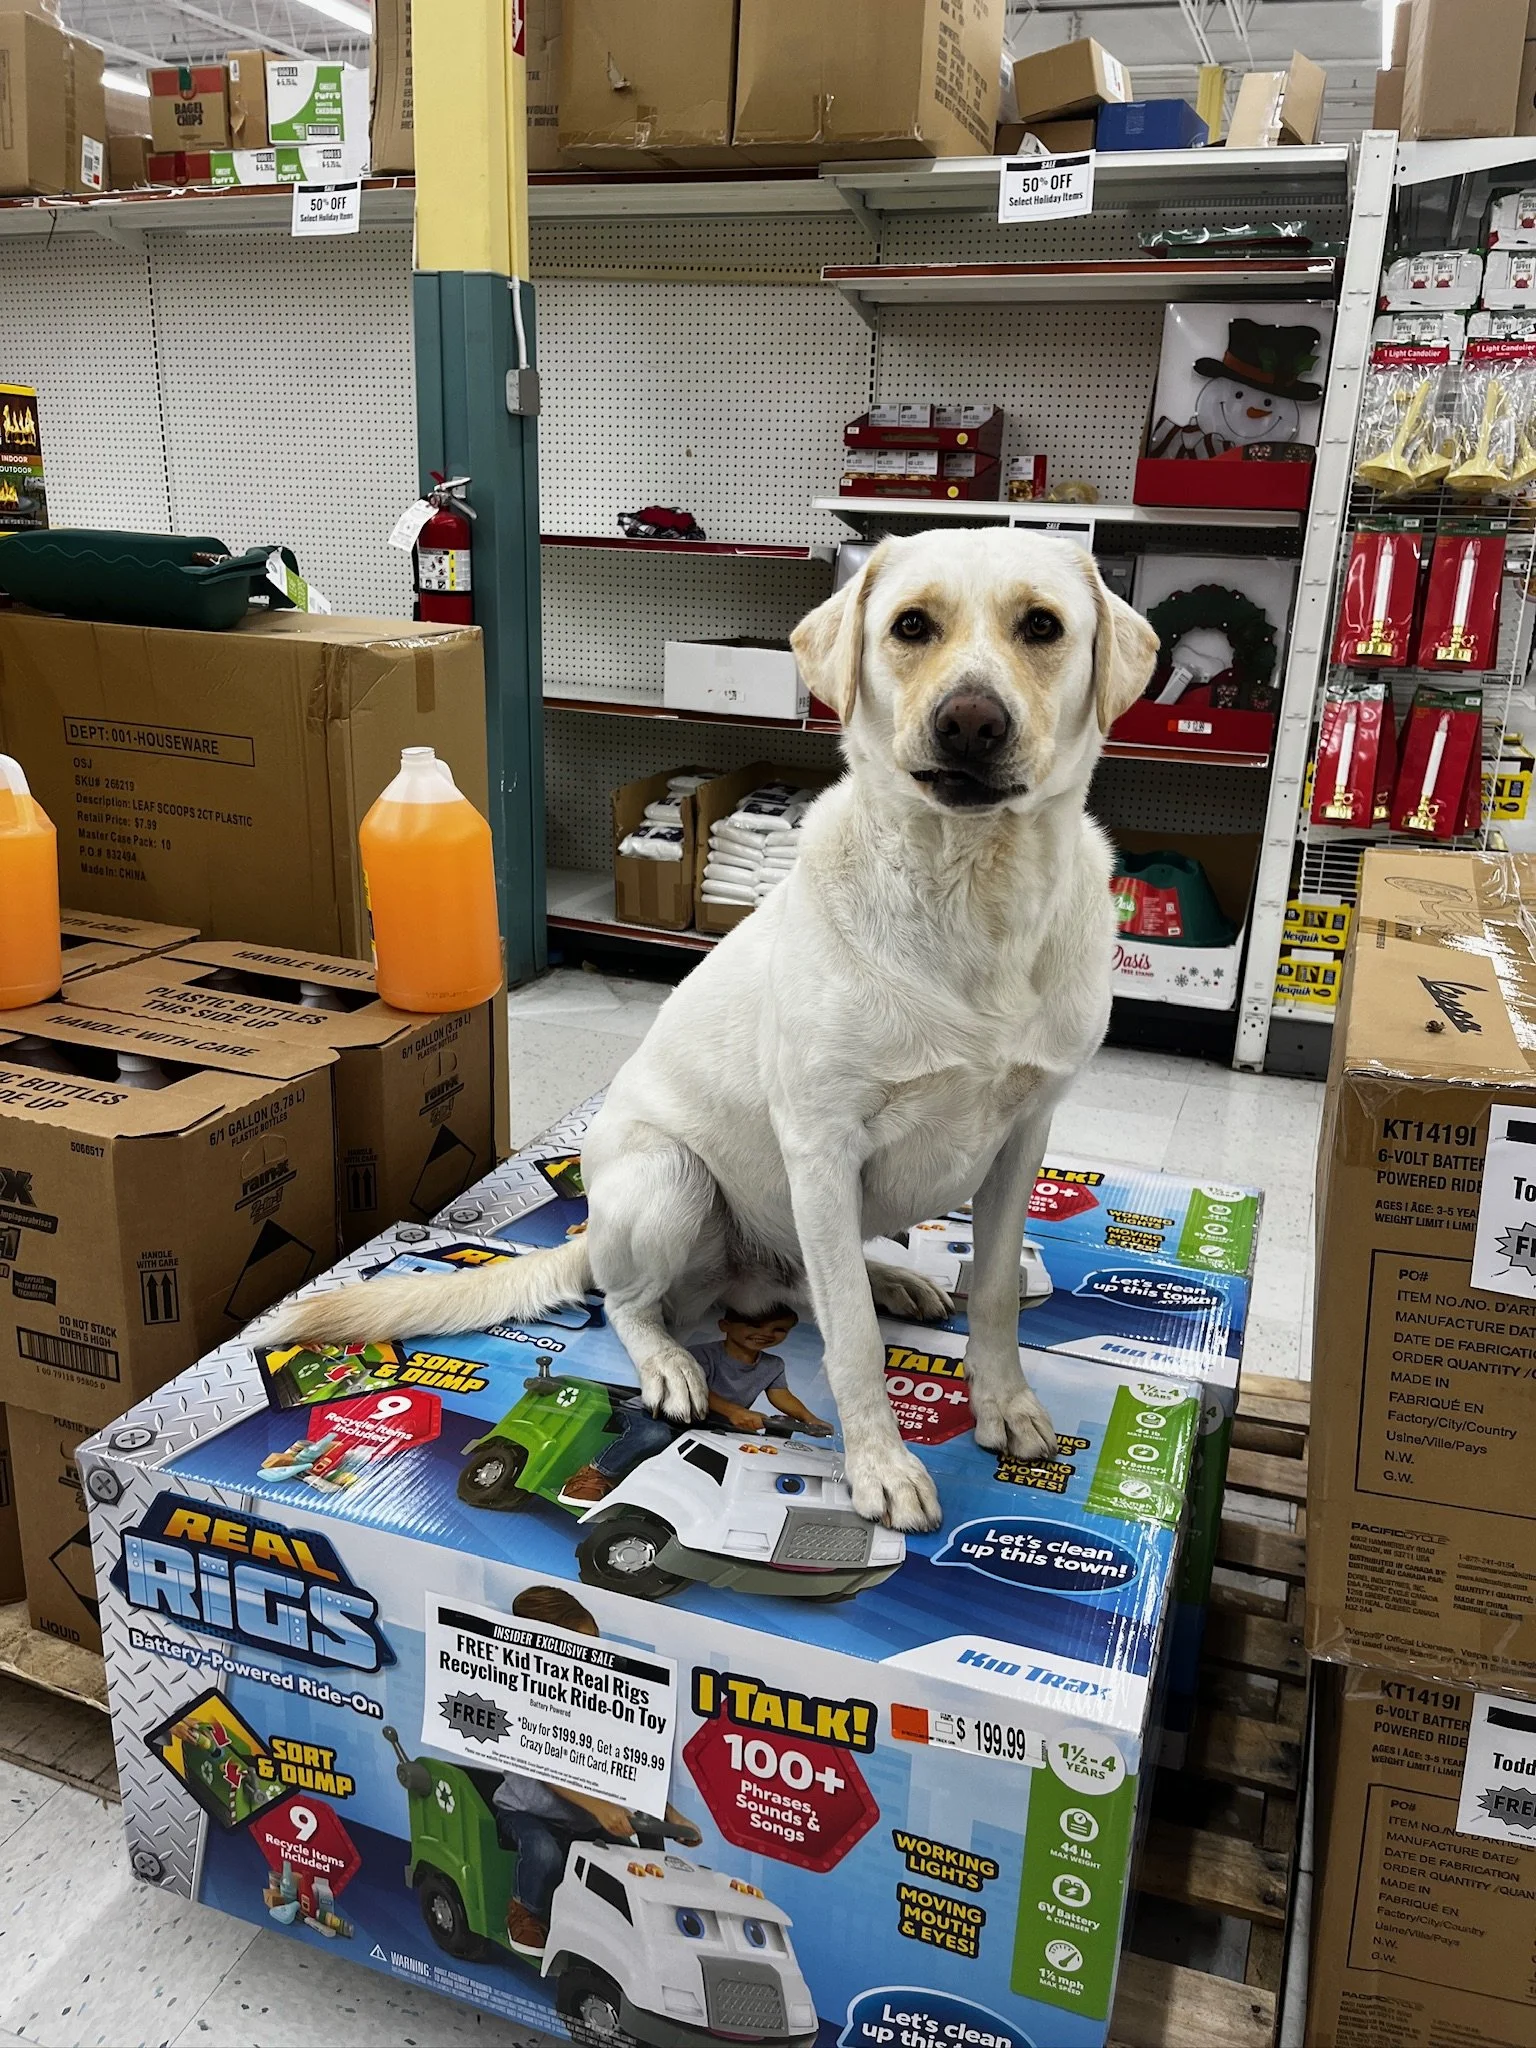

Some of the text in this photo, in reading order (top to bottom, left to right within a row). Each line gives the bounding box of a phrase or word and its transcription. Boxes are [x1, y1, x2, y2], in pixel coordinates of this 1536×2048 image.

[174, 103, 203, 114] BAGEL
[177, 114, 202, 126] CHIPS
[1023, 174, 1073, 193] 50% OFF
[331, 197, 347, 210] OFF
[1009, 192, 1083, 206] Select Holiday Items
[300, 214, 317, 223] Select
[319, 214, 339, 222] Holiday
[1407, 349, 1441, 358] Candolier
[1, 455, 28, 463] INDOOR
[70, 724, 219, 755] DEPT: 001-HOUSEWARE
[73, 758, 92, 769] OSJ
[75, 775, 100, 787] SKU#
[76, 793, 253, 827] Description: LEAF SCOOPS 2CT PLASTIC
[77, 811, 104, 823] Retail
[105, 814, 131, 826] Price:
[78, 828, 171, 850] Master Case Pack: 10
[81, 863, 104, 876] Made
[119, 868, 146, 881] CHINA
[1283, 932, 1319, 943] Nesquik
[233, 950, 369, 978] HANDLE WITH
[1275, 984, 1311, 996] Nesquik
[141, 999, 280, 1030] THIS SIDE UP
[146, 986, 329, 1026] PLASTIC BOTTLES
[46, 1015, 260, 1058] HANDLE WITH CARE
[21, 1075, 128, 1106] BOTTLES
[210, 1088, 305, 1146] 6/1 GALLON (3.78 L)
[231, 1112, 288, 1147] PLASTIC BOTTLES
[1378, 1149, 1429, 1166] 6-VOLT
[1376, 1170, 1447, 1190] POWERED
[136, 1258, 179, 1268] WITH CARE
[141, 1251, 173, 1260] HANDLE
[1399, 1269, 1429, 1282] PO#
[1398, 1290, 1431, 1304] ITEM
[59, 1315, 117, 1338] DO NOT STACK
[1395, 1311, 1505, 1334] MANUFACTURE
[60, 1326, 81, 1340] OVER
[91, 1334, 111, 1347] HIGH
[488, 1326, 564, 1352] Ride-On
[1394, 1332, 1454, 1348] DATE DE
[406, 1353, 483, 1374] SORT
[1392, 1351, 1521, 1377] ORDER QUANTITY
[373, 1364, 486, 1393] & DUMP
[1390, 1371, 1449, 1388] MADE IN
[1389, 1392, 1484, 1414] FABRIQUÉ EN
[1387, 1410, 1517, 1440] Factory/City/Country
[1386, 1431, 1488, 1454] Usine/Ville/Pays
[1384, 1450, 1415, 1464] N.W.
[1383, 1470, 1414, 1484] G.W.
[163, 1508, 340, 1582] REAL
[985, 1529, 1113, 1561] Let's clean
[961, 1542, 1128, 1578] up this town!
[40, 1617, 80, 1643] LIQUID
[493, 1625, 615, 1668] INSIDER EXCLUSIVE SALE
[132, 1632, 380, 1716] Battery-Powered Ride-On
[503, 1647, 530, 1670] Kid
[534, 1655, 569, 1680] Trax
[573, 1666, 609, 1692] Real
[613, 1678, 649, 1704] Rigs
[440, 1650, 666, 1734] Recycling Truck Ride-On Toy
[530, 1699, 571, 1718] Battery Powered
[700, 1674, 870, 1746] I TALK!
[538, 1722, 550, 1737] for
[552, 1726, 594, 1752] $199.99,
[597, 1739, 614, 1754] Get
[615, 1747, 620, 1758] a
[623, 1746, 665, 1771] $199.99
[974, 1720, 1026, 1761] 199.99
[271, 1739, 334, 1770] SORT
[520, 1735, 543, 1754] Crazy
[569, 1750, 586, 1766] Gift
[587, 1754, 609, 1774] Card,
[611, 1762, 637, 1781] FREE!
[723, 1734, 845, 1794] 100+
[258, 1758, 352, 1796] & DUMP
[1066, 1762, 1105, 1780] YEARS
[740, 1780, 816, 1817] Phrases,
[290, 1806, 317, 1841] 9
[736, 1794, 820, 1832] Sounds &
[750, 1813, 805, 1843] Songs
[266, 1833, 345, 1867] Recycle Items
[280, 1848, 330, 1872] Included
[896, 1834, 995, 1876] WORKING
[1050, 1849, 1101, 1870] MAX WEIGHT
[1060, 1842, 1092, 1859] 44 lb
[909, 1856, 979, 1889] LIGHTS
[900, 1887, 982, 1924] MOVING
[1038, 1901, 1100, 1930] 6V Battery
[903, 1905, 976, 1938] MOUTH
[902, 1923, 976, 1956] & EYES!
[390, 1951, 432, 1978] WARNING:
